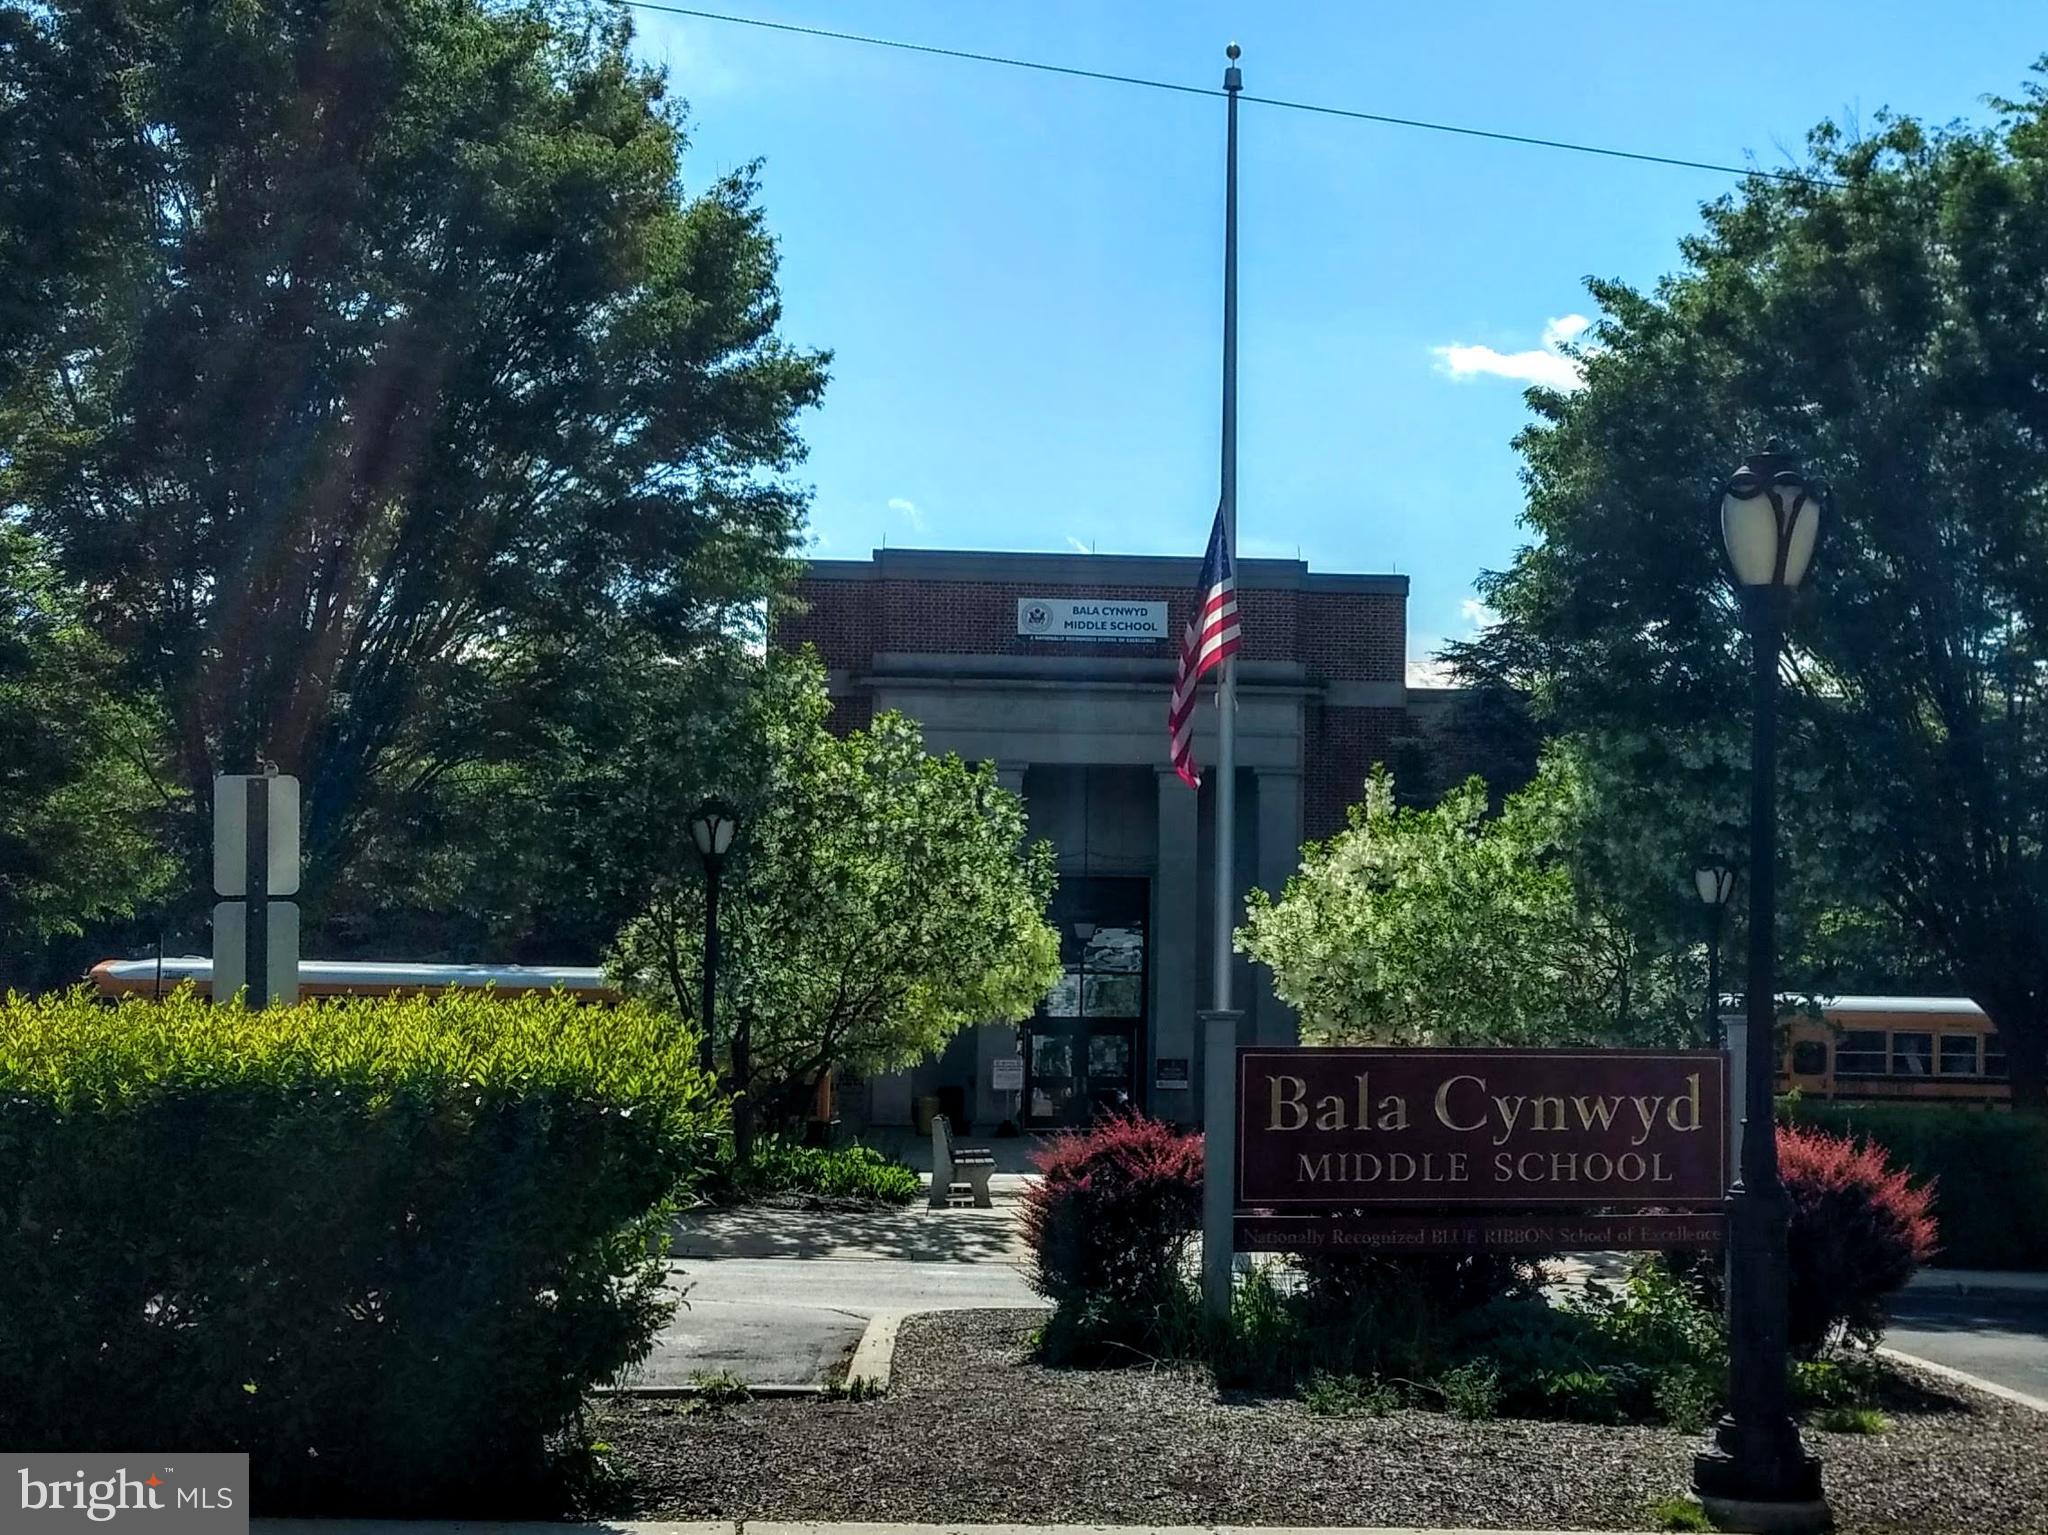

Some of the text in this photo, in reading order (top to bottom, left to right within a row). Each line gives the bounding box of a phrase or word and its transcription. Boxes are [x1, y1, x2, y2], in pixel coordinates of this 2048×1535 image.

[1072, 606, 1148, 617] BALA CYNWYD
[1064, 620, 1158, 632] MIDDLE SCHOOL
[1264, 1072, 1703, 1146] Bala Cynwyd
[1297, 1152, 1673, 1183] MIDDLE SCHOOL
[1243, 1225, 1722, 1248] Nationally Recognized BLUE RIBBON School of Excellence
